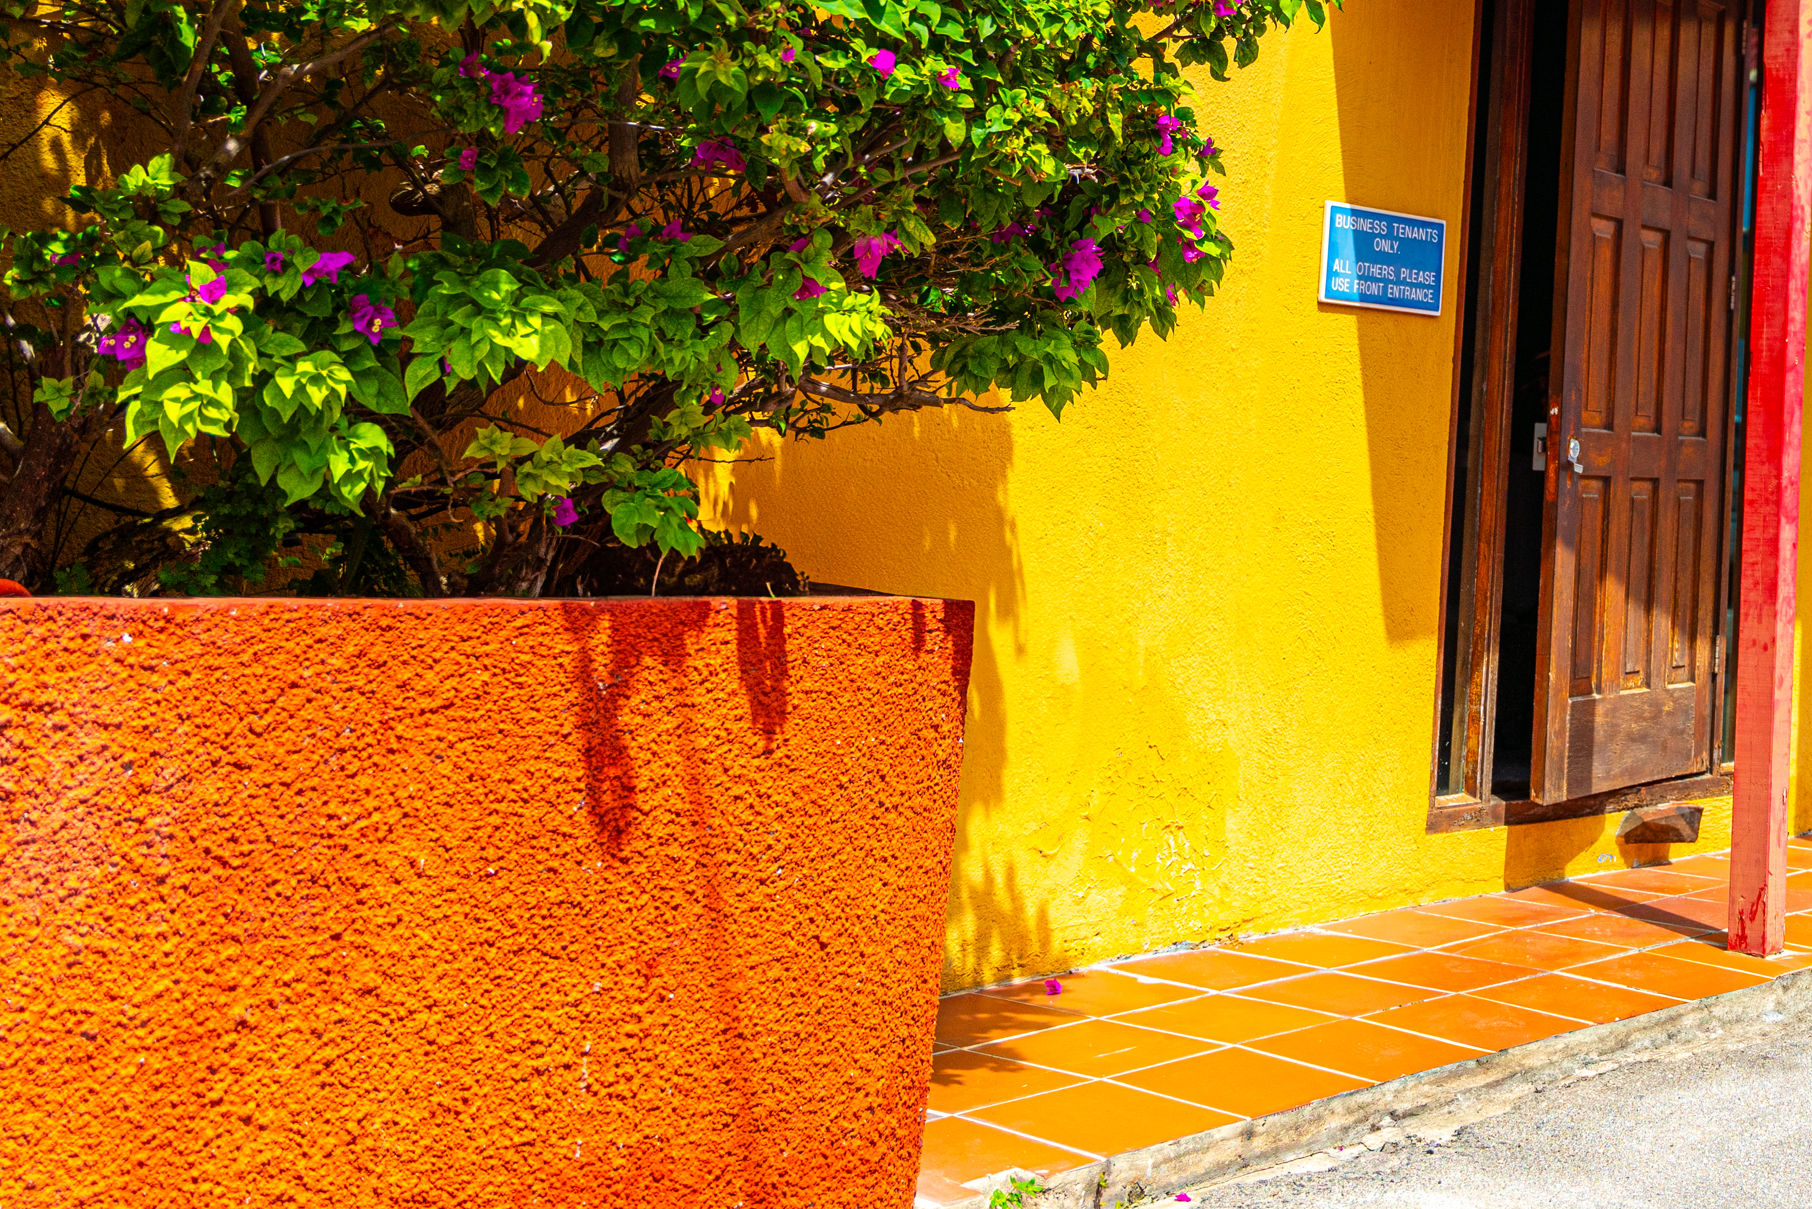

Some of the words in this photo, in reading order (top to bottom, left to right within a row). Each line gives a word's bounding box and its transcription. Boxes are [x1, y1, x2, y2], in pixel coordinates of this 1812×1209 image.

[1335, 213, 1388, 235] BUSINESS
[1393, 223, 1439, 243] TENANTS
[1373, 237, 1401, 255] ONLY.
[1332, 258, 1352, 274] ALL
[1400, 267, 1436, 286] PLEASE
[1331, 277, 1350, 291] USE
[1353, 279, 1385, 297] FRONT
